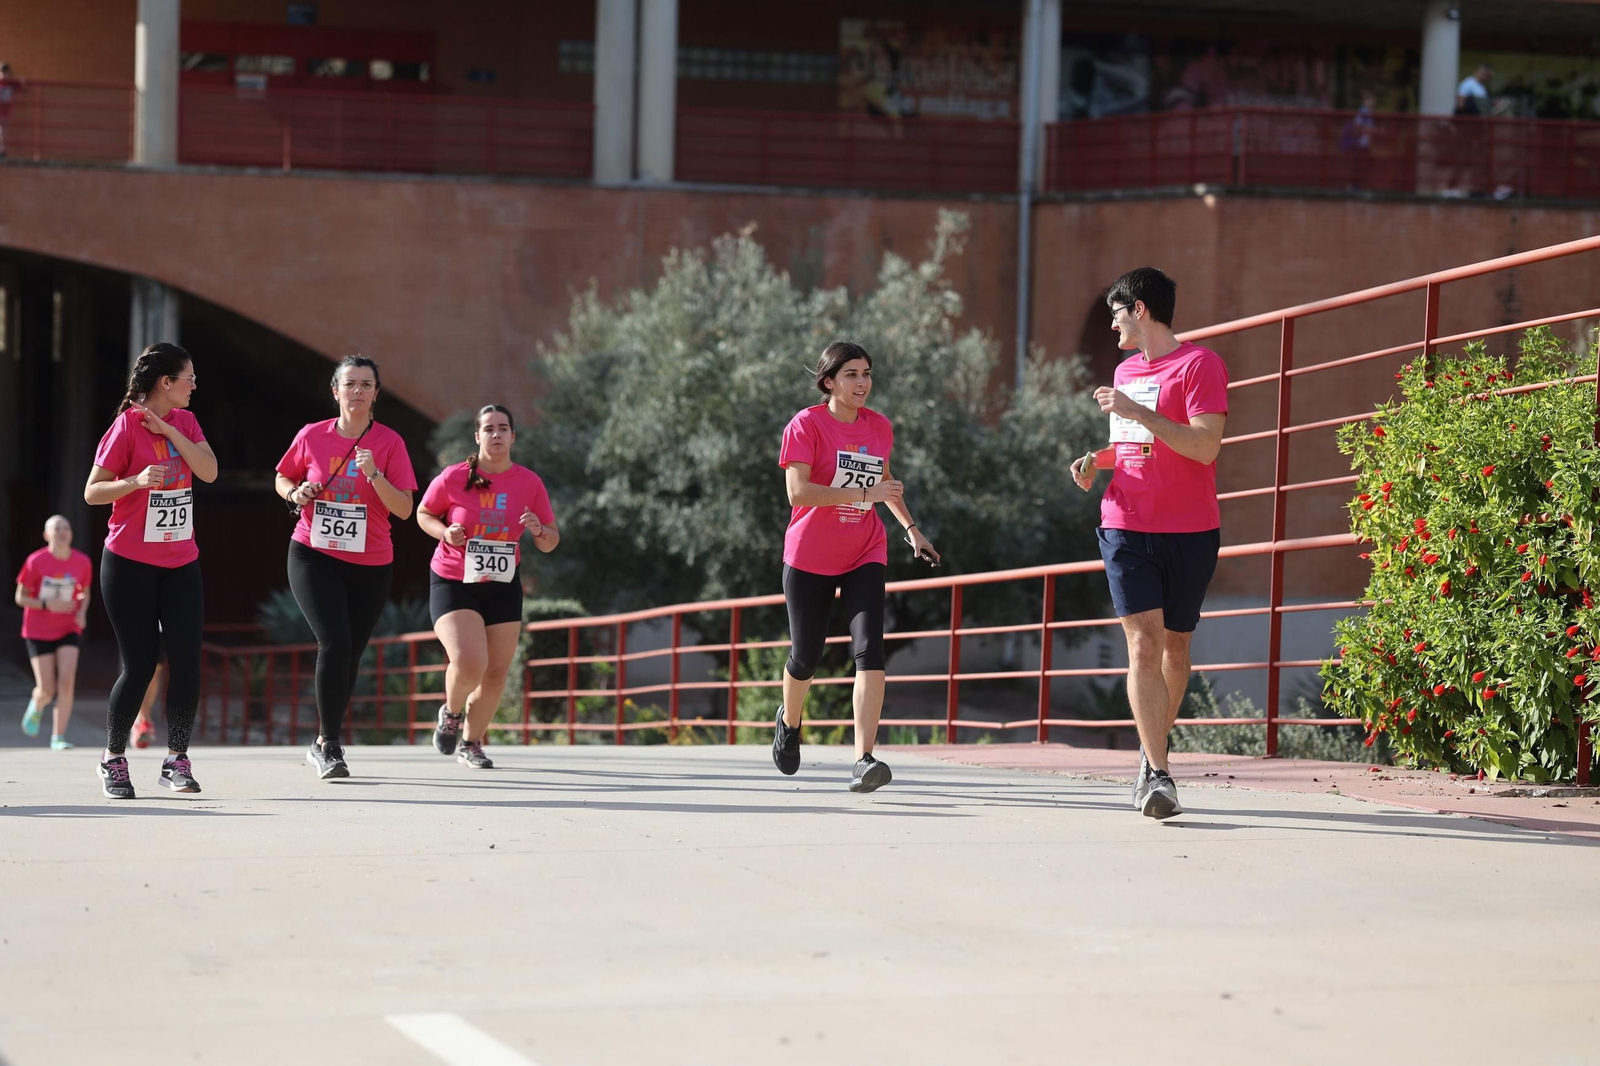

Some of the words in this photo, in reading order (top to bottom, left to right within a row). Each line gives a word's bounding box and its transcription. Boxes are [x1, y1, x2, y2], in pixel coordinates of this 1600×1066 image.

[329, 456, 360, 478] WE
[840, 459, 863, 471] UMA
[840, 471, 876, 488] 259
[151, 499, 175, 507] UMA
[479, 492, 508, 510] WE
[156, 507, 187, 527] 219
[316, 506, 340, 517] UMA
[320, 518, 358, 538] 564
[468, 545, 491, 553] UMA
[474, 555, 508, 572] 340
